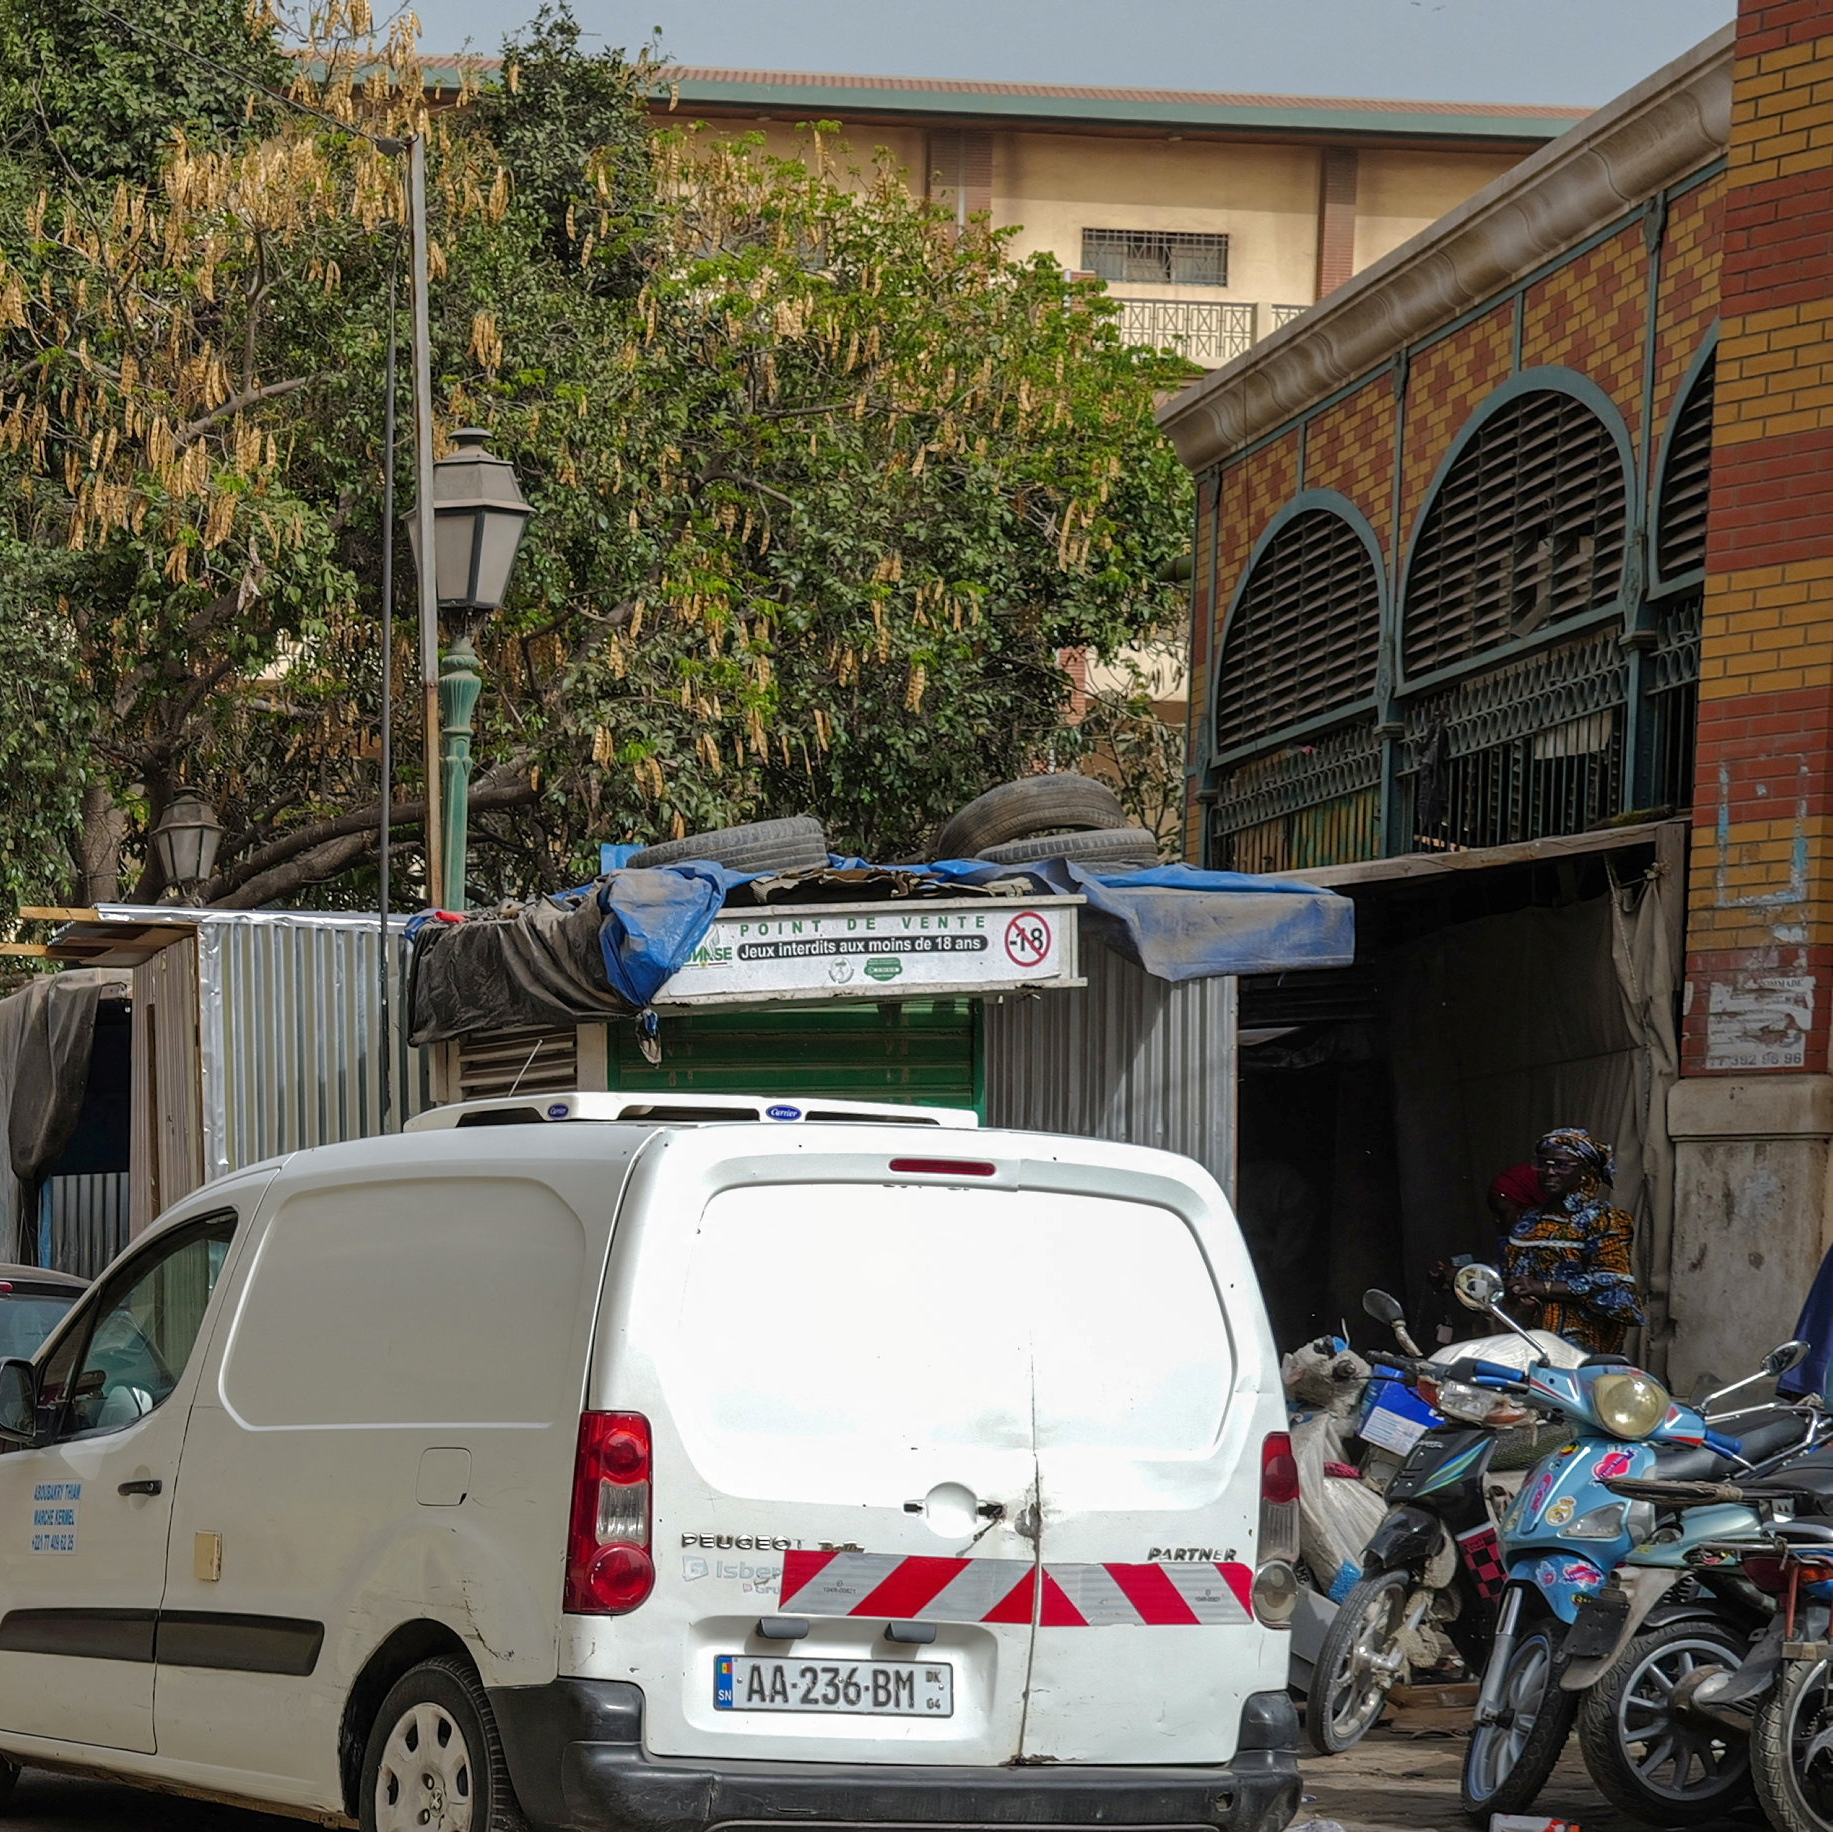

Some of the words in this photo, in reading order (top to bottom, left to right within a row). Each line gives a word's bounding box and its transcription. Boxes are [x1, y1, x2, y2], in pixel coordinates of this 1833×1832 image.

[740, 919, 822, 937] POINT
[847, 918, 876, 932] DE
[903, 915, 985, 930] VENTE
[684, 945, 733, 963] NASE
[741, 943, 775, 960] Jeux
[778, 939, 837, 957] interdits
[839, 941, 865, 953] aux
[869, 936, 911, 952] moins
[915, 934, 932, 951] de
[935, 935, 952, 950] 18
[955, 937, 981, 950] ans
[770, 1108, 798, 1118] Carrier
[681, 1532, 805, 1551] PEUGEOT
[1147, 1547, 1238, 1562] PARTNER
[925, 1670, 941, 1683] DK
[718, 1689, 732, 1701] SN
